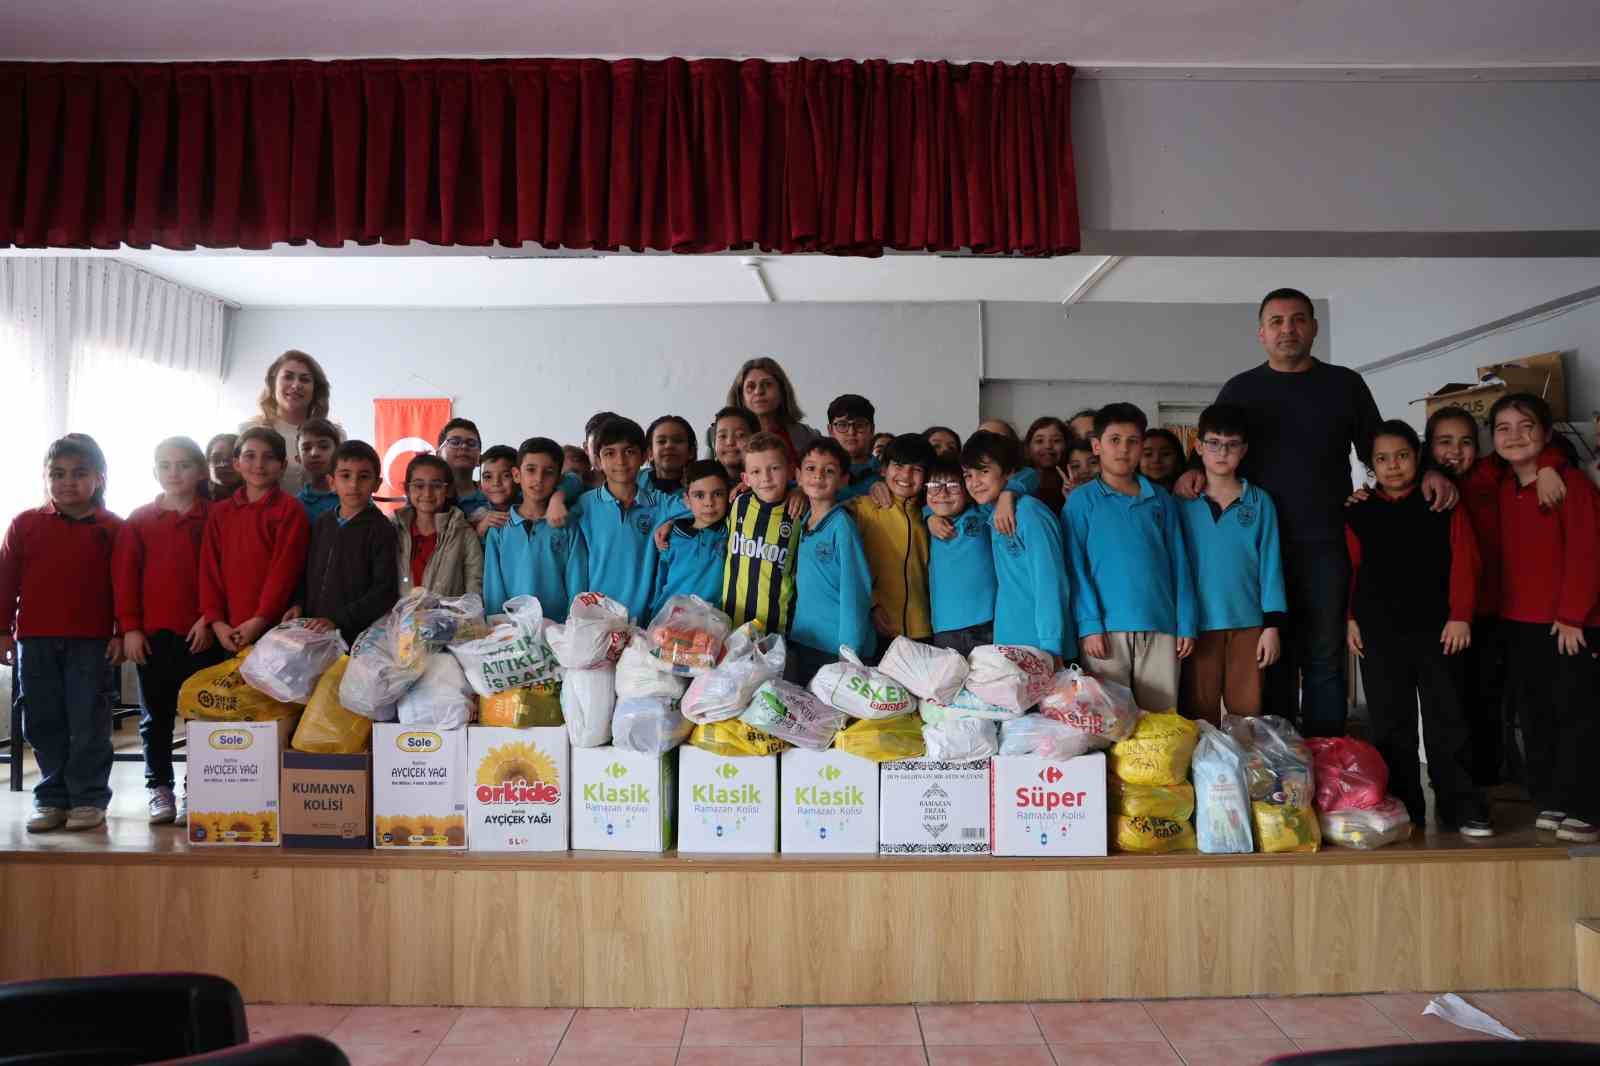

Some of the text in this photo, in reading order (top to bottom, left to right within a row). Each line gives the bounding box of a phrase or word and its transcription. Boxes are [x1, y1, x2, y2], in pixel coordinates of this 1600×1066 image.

[219, 735, 244, 745] Sole
[407, 737, 432, 747] Sole
[292, 783, 355, 795] KUMANYA
[476, 780, 560, 804] orkide
[583, 782, 650, 803] Klasik
[692, 783, 762, 803] Klasik
[794, 784, 865, 805] Klasik
[303, 798, 343, 811] KOLİSİ
[1015, 786, 1087, 811] Süper
[797, 806, 836, 816] Ramazan
[1016, 811, 1058, 820] Ramazan
[484, 812, 552, 827] AYÇİÇEK YAĞI
